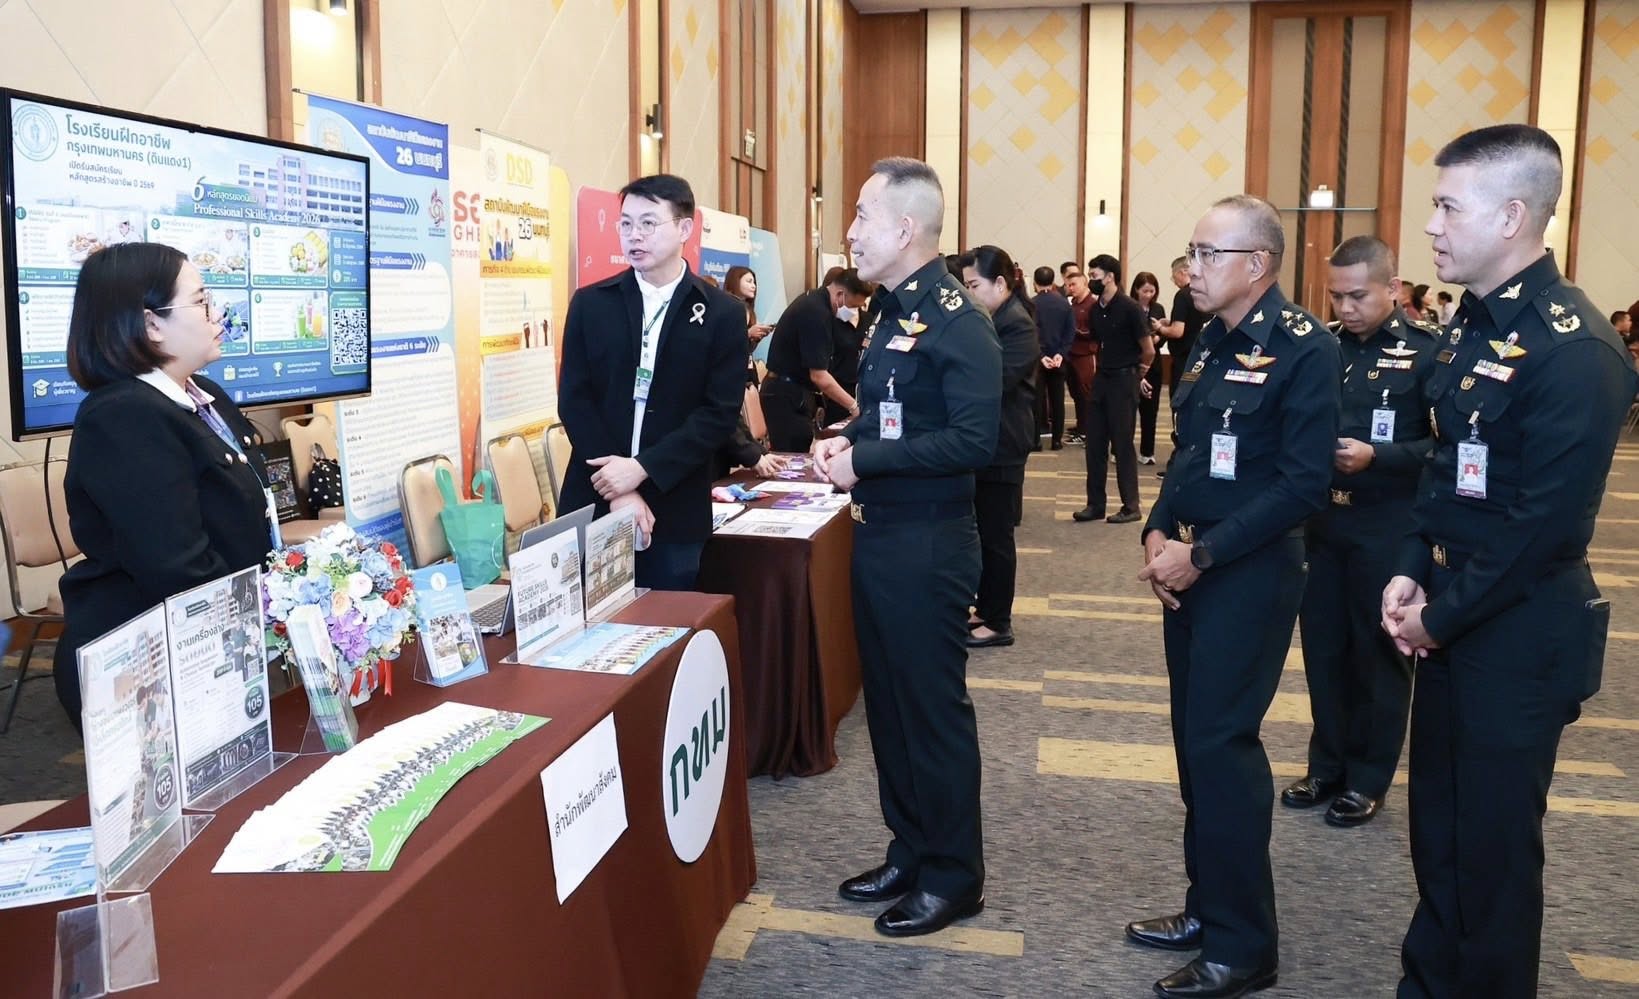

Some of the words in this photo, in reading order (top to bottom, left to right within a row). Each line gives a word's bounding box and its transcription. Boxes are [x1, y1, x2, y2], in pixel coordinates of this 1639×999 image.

[66, 114, 171, 150] โรงเรียนฝึกอาชีพ
[66, 140, 144, 163] กรุงเทพมหานคร
[146, 153, 192, 171] (ดินแดง1)
[69, 160, 123, 176] เปิดรับสมัครเรียน
[506, 153, 534, 184] DSD
[193, 203, 243, 218] Professional
[244, 207, 267, 220] Skills
[519, 217, 532, 240] 26
[176, 623, 225, 651] งานเครื่องล่าง
[247, 694, 263, 713] 105
[669, 685, 725, 817] กทม
[156, 775, 172, 799] 105
[554, 765, 617, 838] สำนักพัฒนาสังคม
